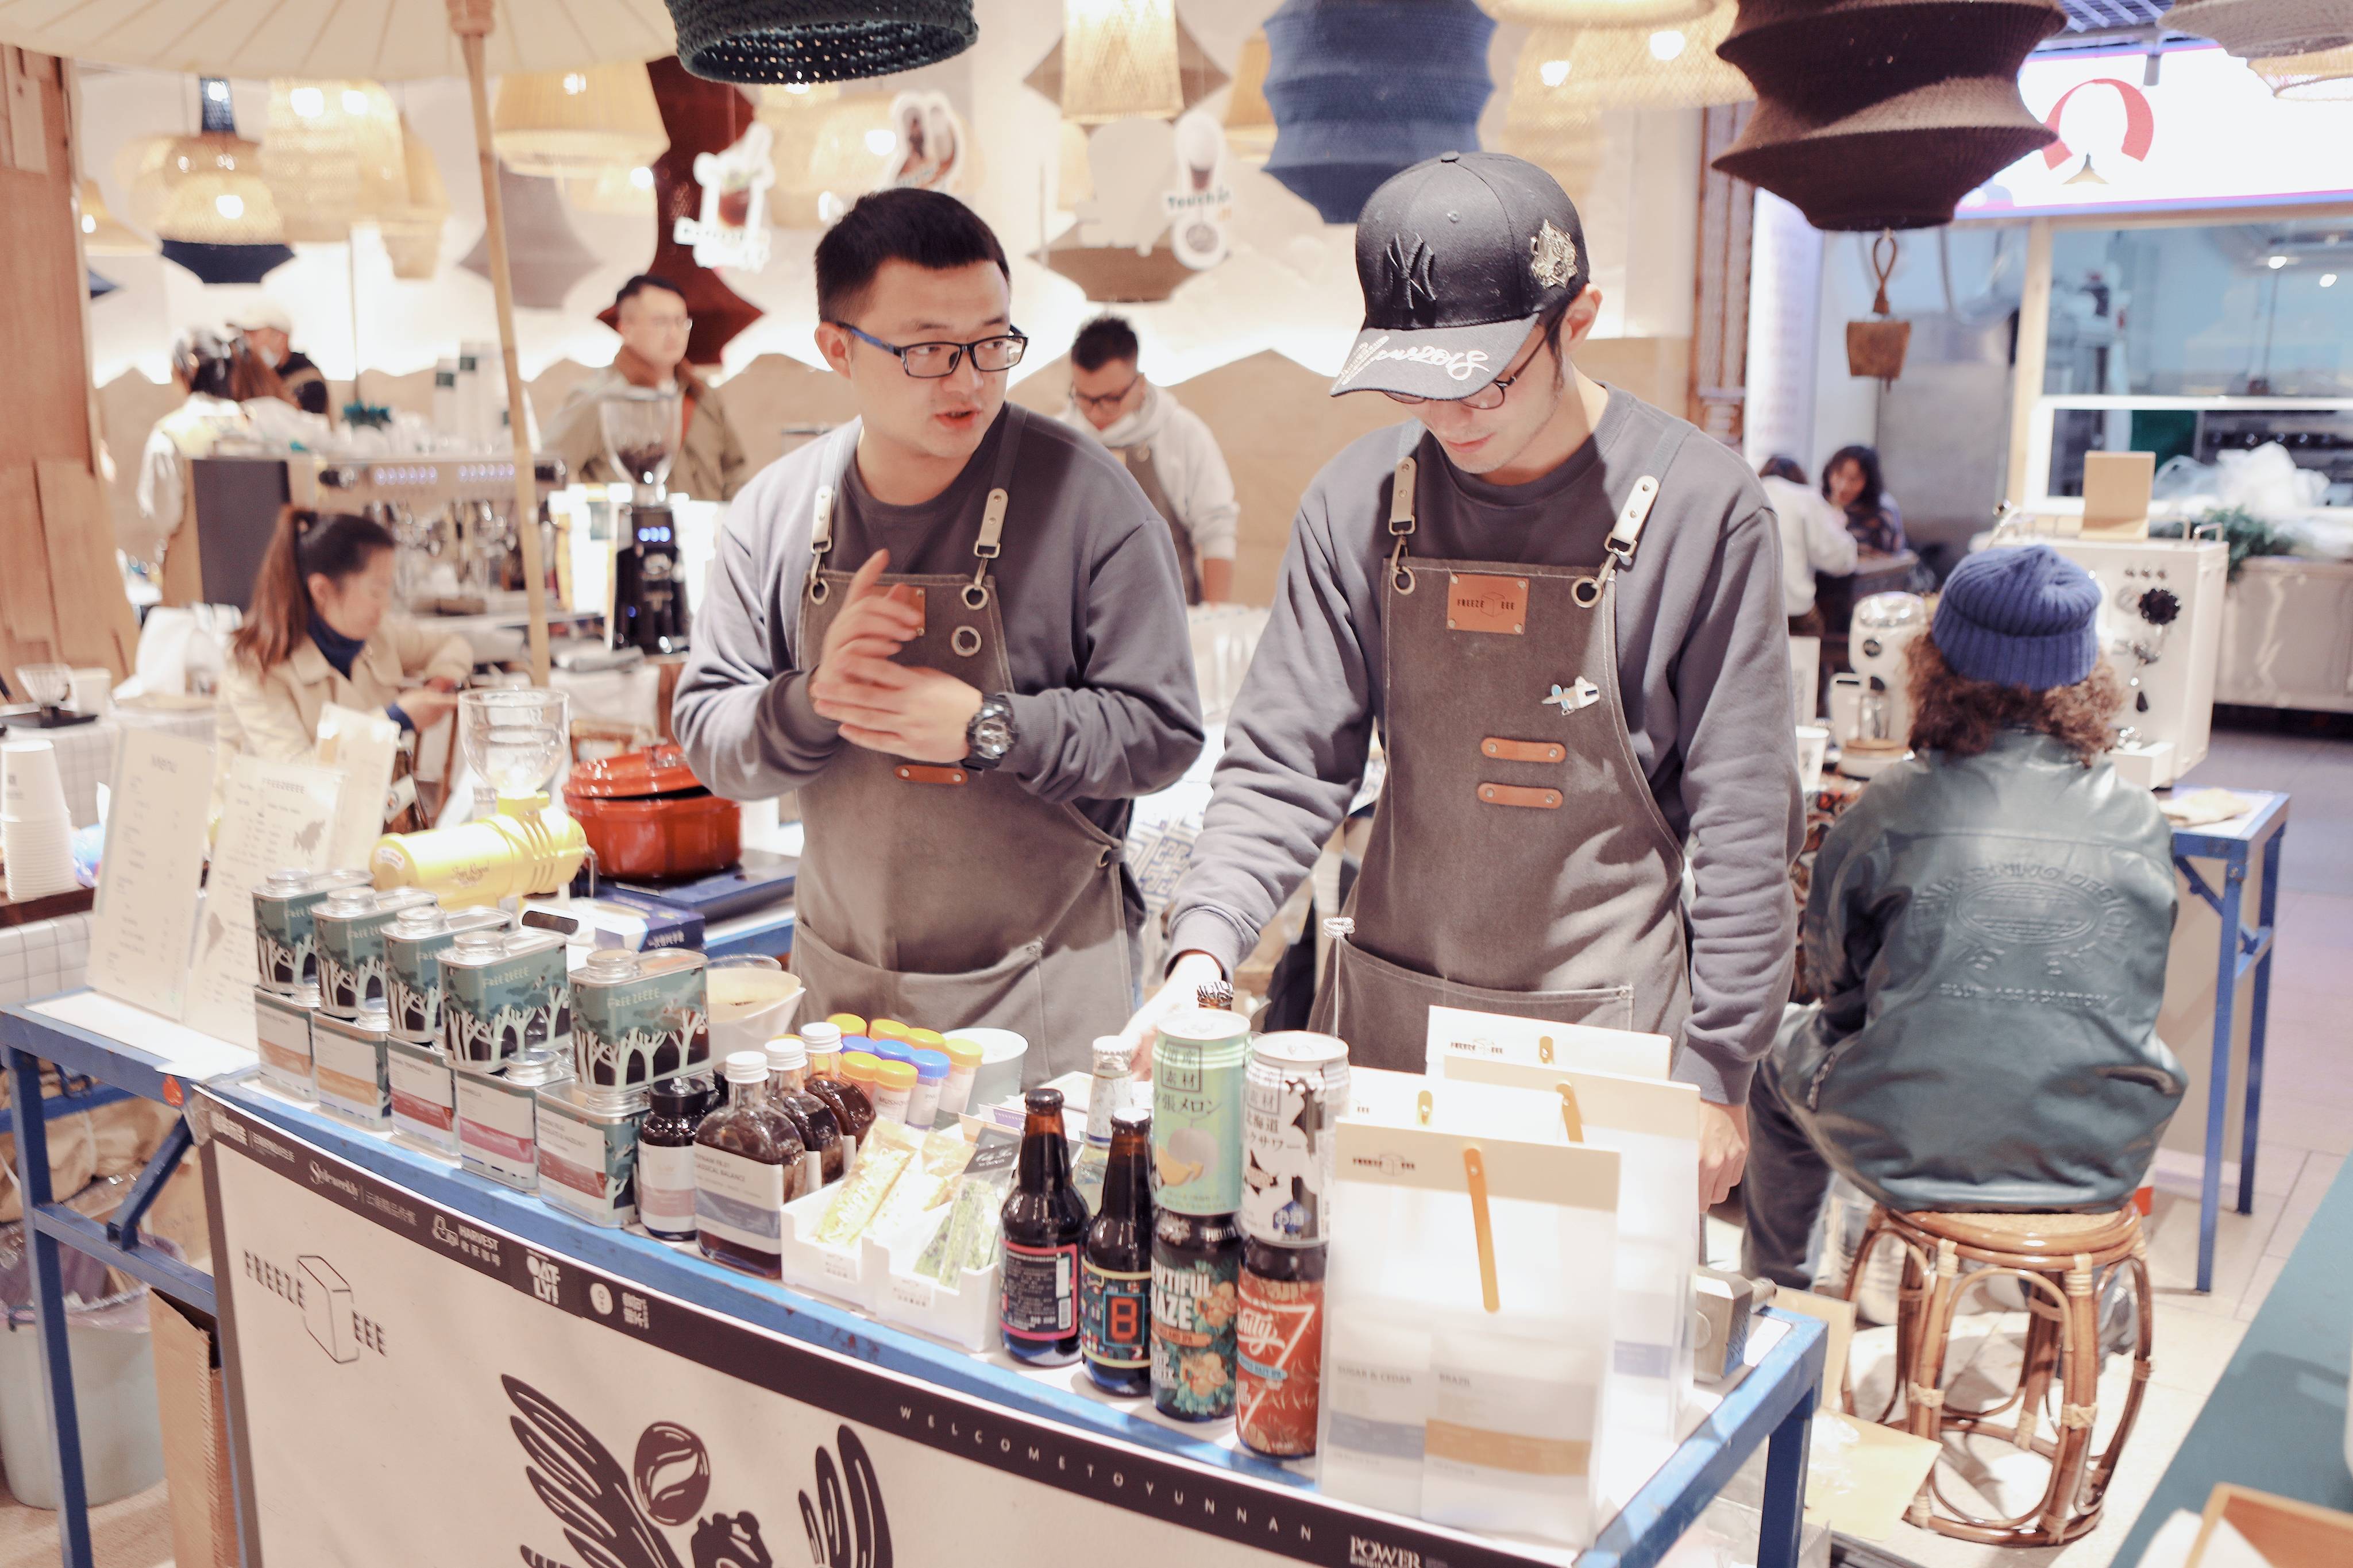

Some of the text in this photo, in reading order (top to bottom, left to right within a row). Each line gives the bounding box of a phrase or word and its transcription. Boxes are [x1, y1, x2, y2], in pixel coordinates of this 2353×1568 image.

[1457, 599, 1515, 610] FREEZE EEE
[458, 1223, 499, 1251] HARVEST
[244, 1249, 388, 1359] FREEZE EEE
[1380, 1373, 1412, 1385] CEDAR
[1351, 1535, 1421, 1568] POWER
